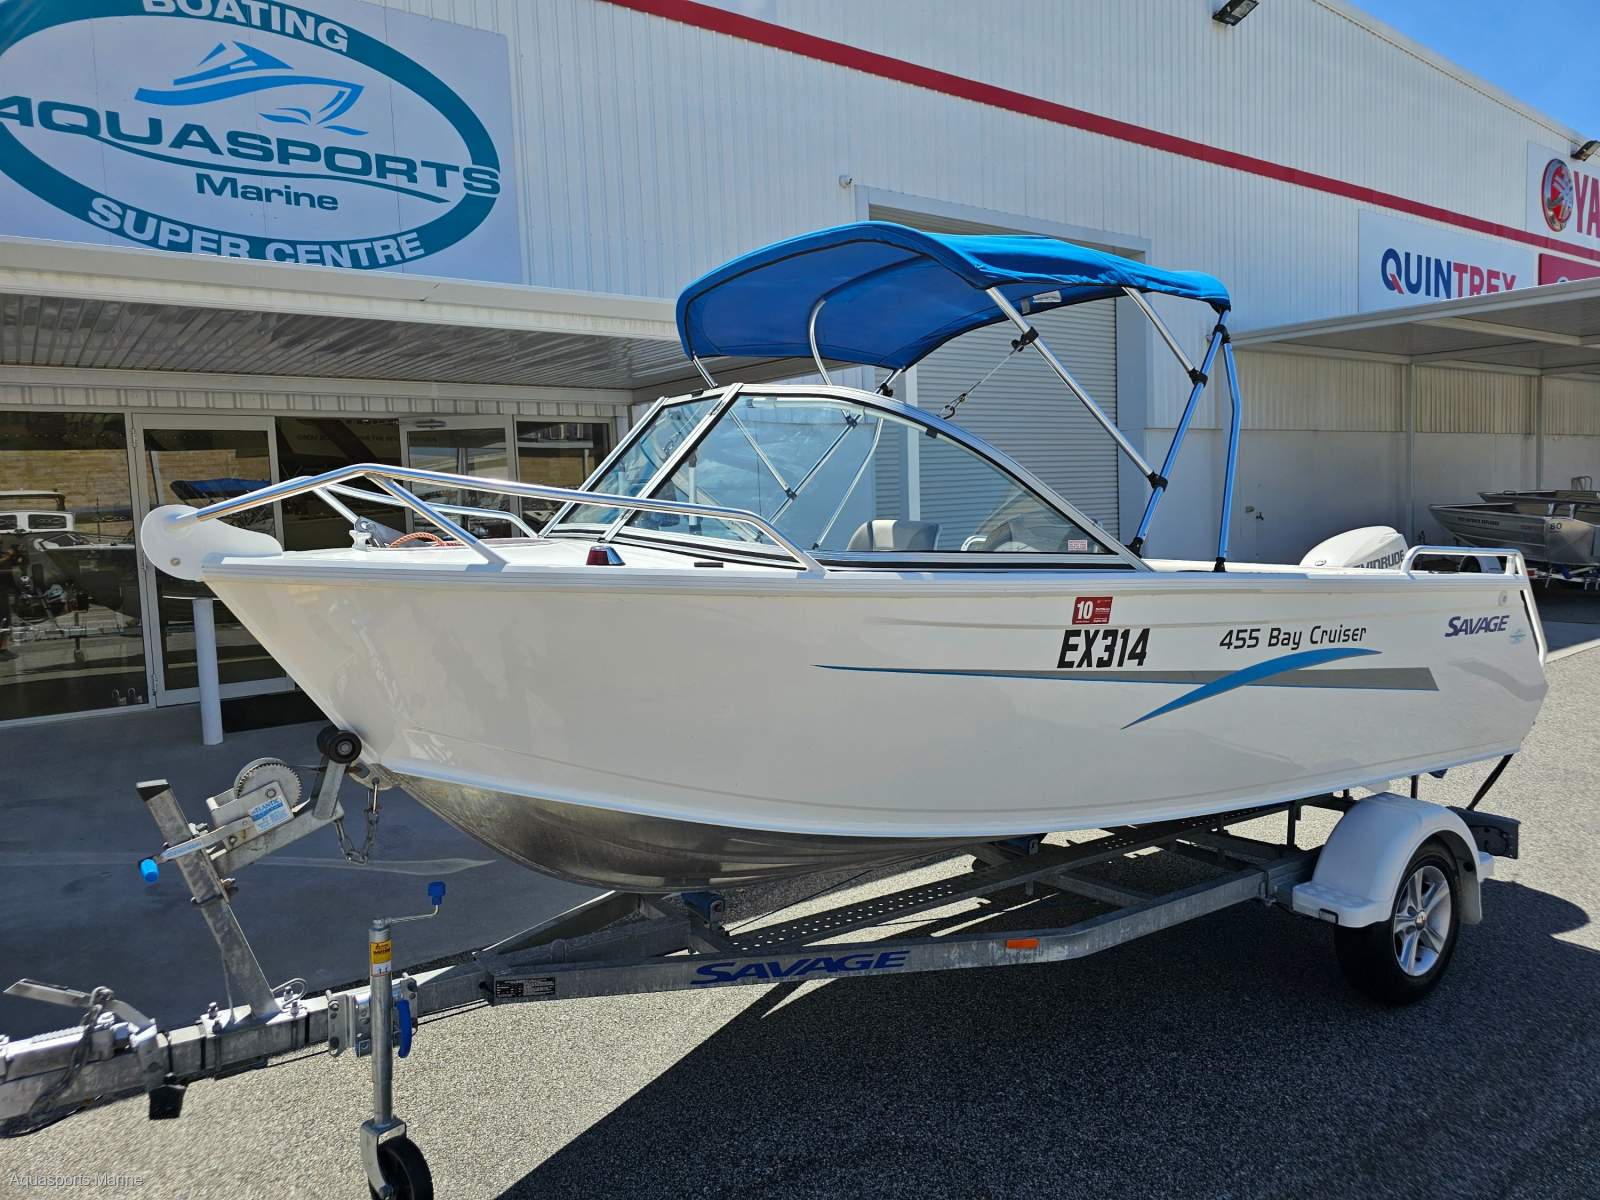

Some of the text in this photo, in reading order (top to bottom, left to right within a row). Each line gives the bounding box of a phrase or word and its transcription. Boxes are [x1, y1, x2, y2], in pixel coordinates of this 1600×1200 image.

[0, 95, 501, 195] AQUASPORTS
[196, 172, 339, 211] Marine
[88, 197, 425, 268] SUPER CENTRE
[1353, 549, 1405, 569] INRUDE
[1076, 600, 1094, 620] 10
[1444, 614, 1511, 637] SAVAGE
[1056, 628, 1150, 668] EX314
[1219, 624, 1367, 650] 455 Bay Cruiser
[690, 950, 911, 985] SAVAGE
